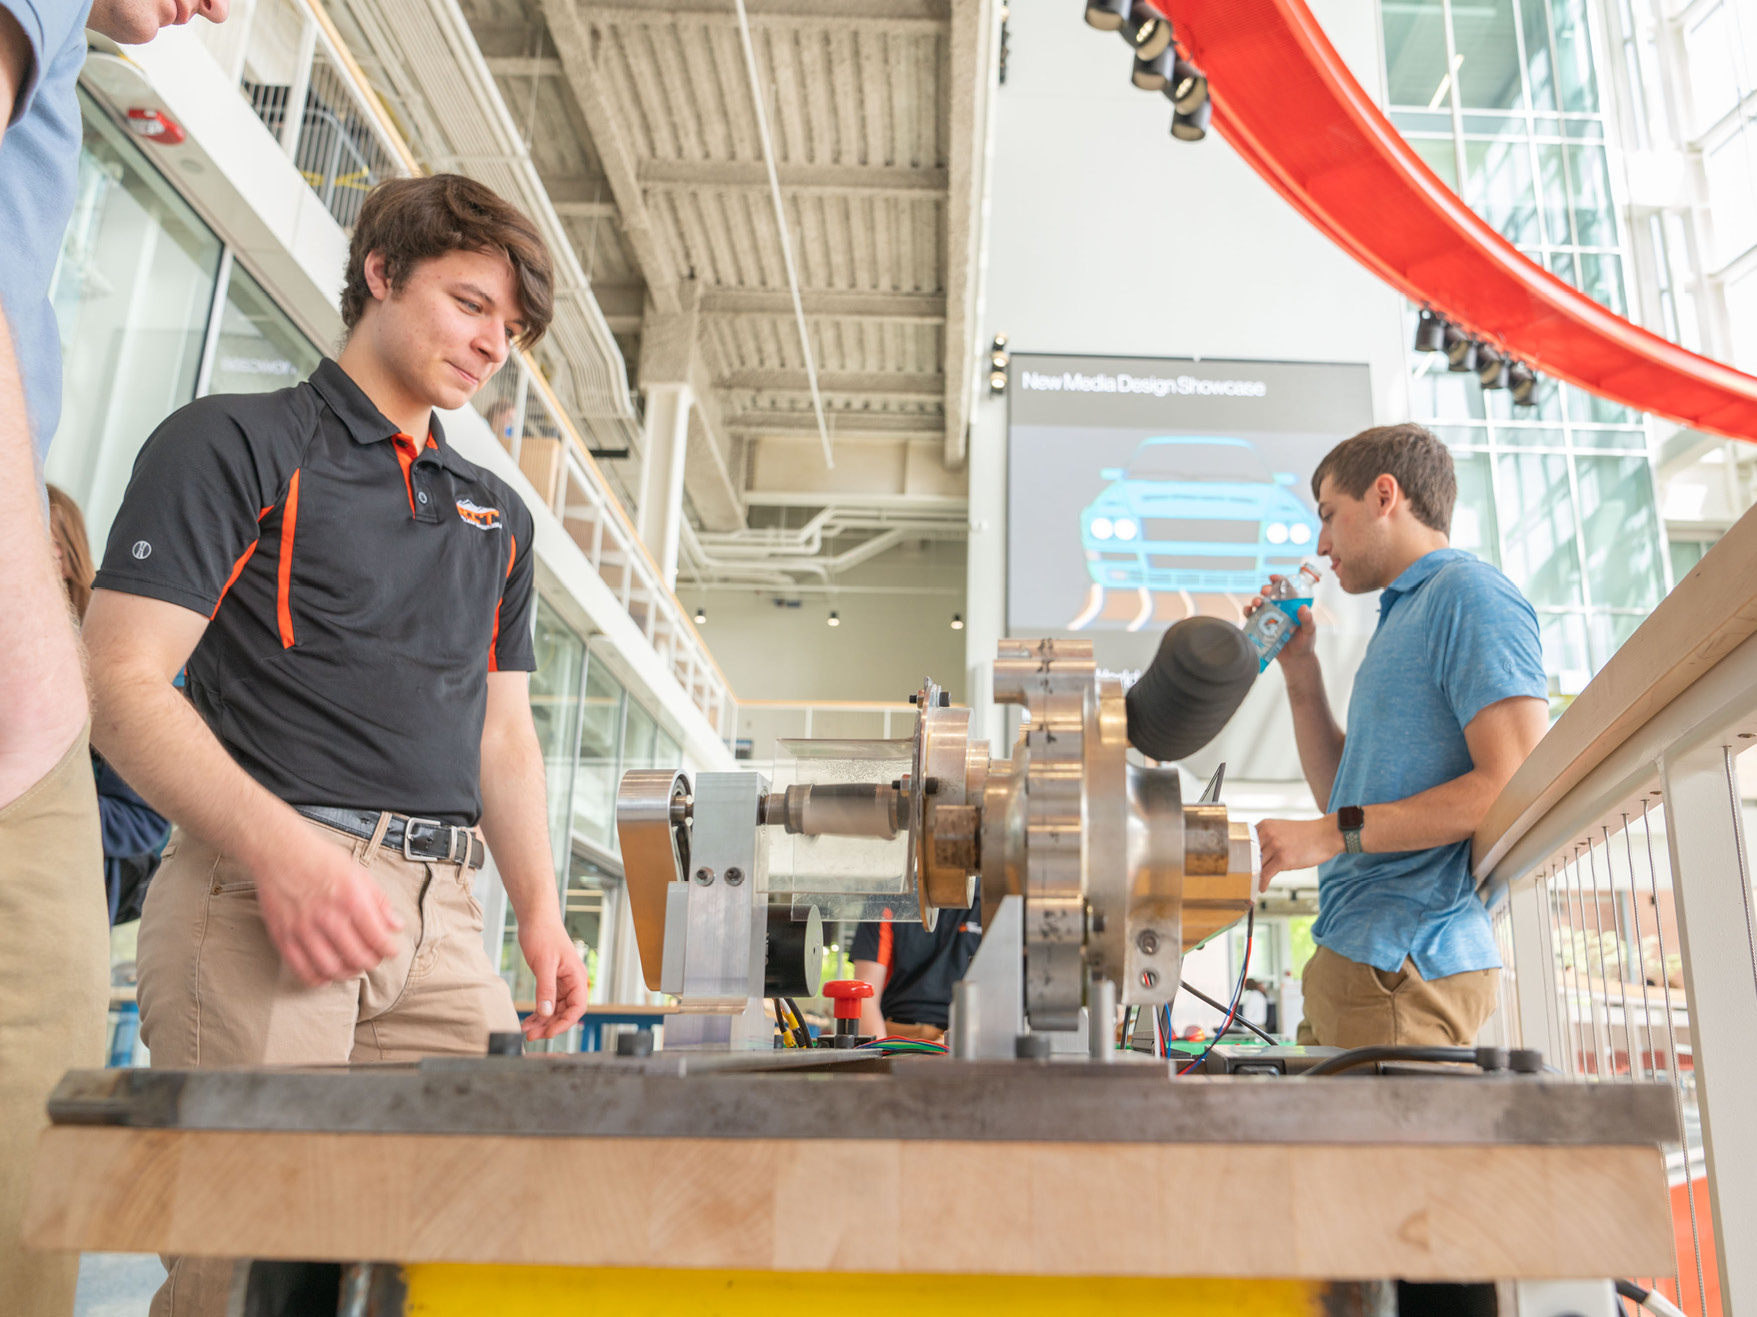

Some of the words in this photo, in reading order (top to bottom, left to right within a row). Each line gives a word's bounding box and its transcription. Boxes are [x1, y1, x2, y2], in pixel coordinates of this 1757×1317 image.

[1022, 371, 1063, 391] New
[1063, 372, 1117, 392] Media
[1117, 374, 1177, 397] Design
[1177, 375, 1266, 397] Showcase
[1258, 611, 1284, 637] G
